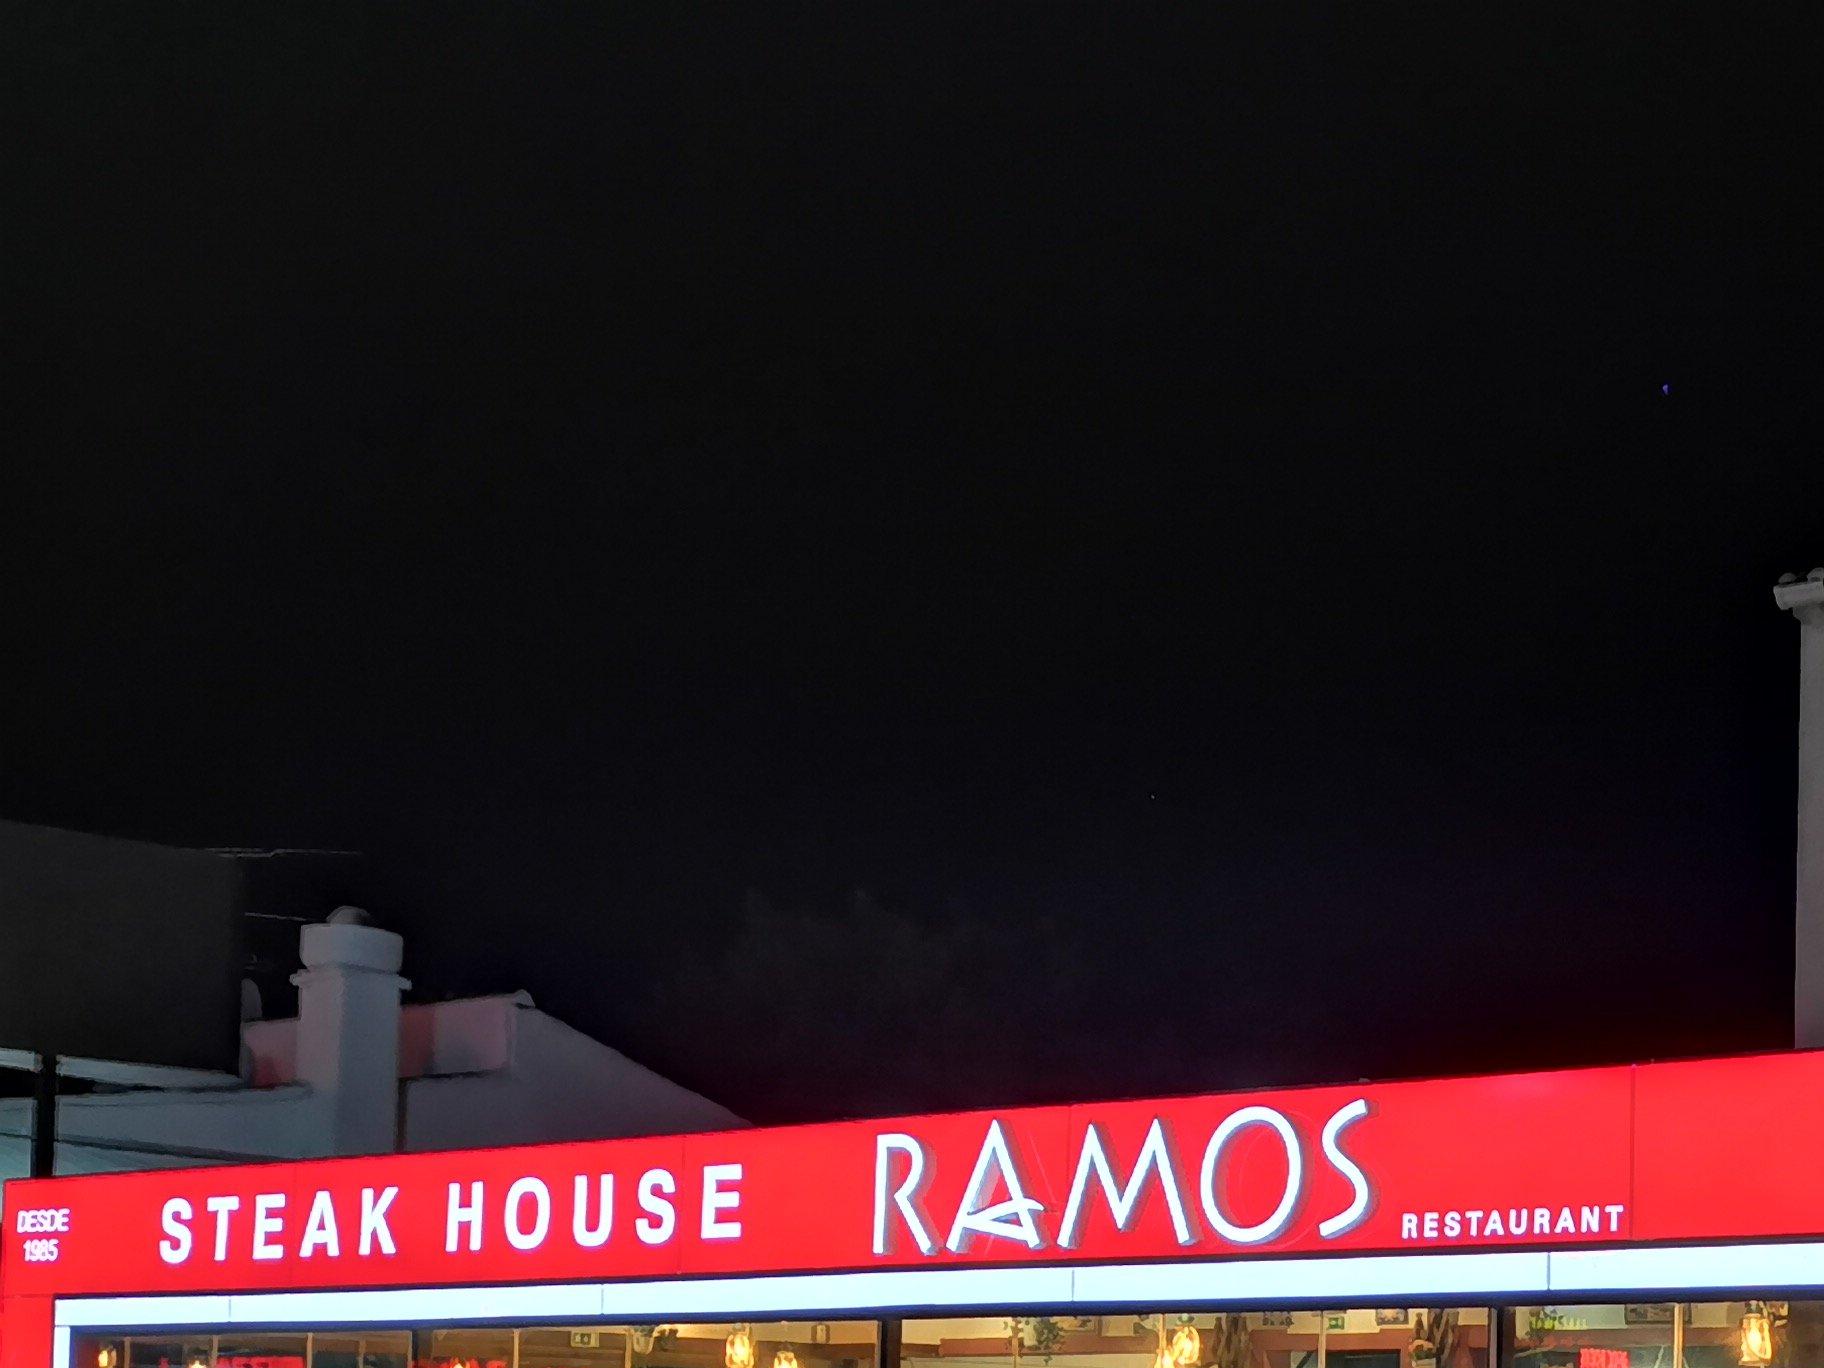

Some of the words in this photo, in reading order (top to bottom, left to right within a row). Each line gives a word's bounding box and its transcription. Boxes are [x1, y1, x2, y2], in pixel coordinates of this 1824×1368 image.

[872, 1098, 1370, 1256] RAMOS
[17, 1208, 70, 1233] DESDE
[159, 1185, 399, 1265] STEAK
[445, 1163, 744, 1254] HOUSE
[1401, 1204, 1625, 1240] RESTAURANT
[23, 1239, 59, 1262] 1985
